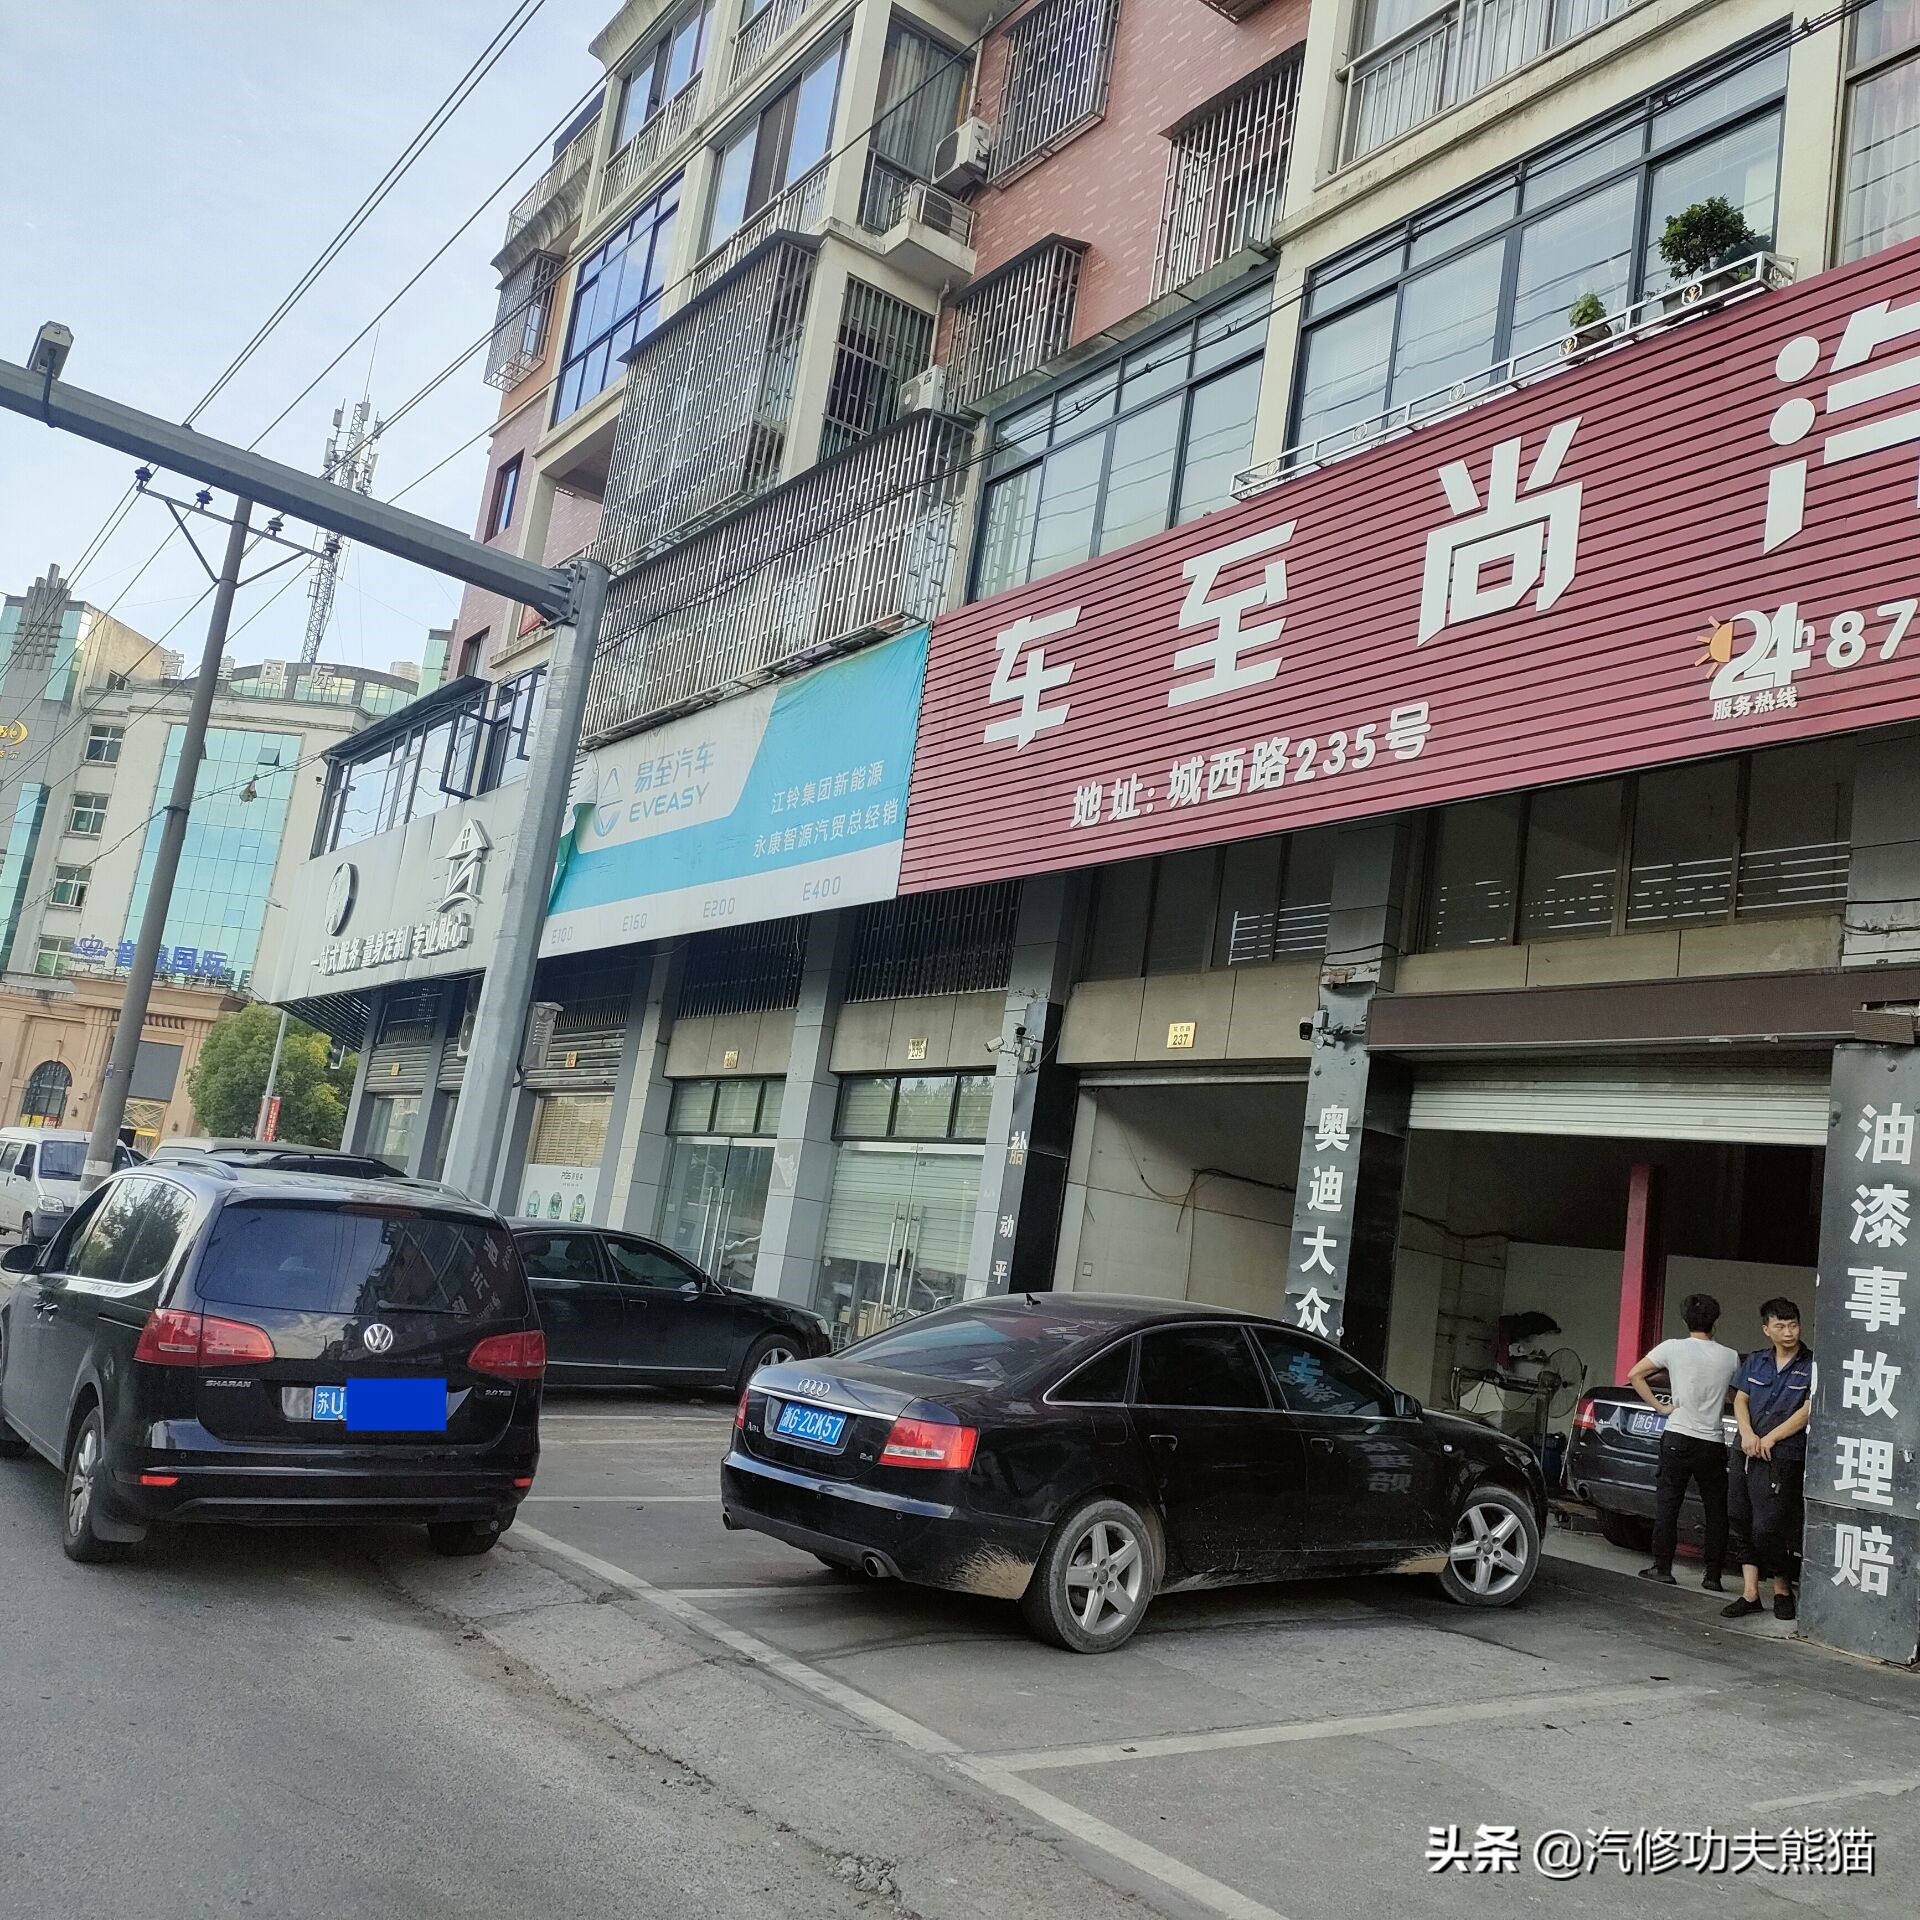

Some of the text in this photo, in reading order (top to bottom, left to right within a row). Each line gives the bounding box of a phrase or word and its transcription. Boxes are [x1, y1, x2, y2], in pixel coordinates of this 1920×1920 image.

[1712, 686, 1798, 721] 服务热线
[634, 742, 717, 794] 易至汽车
[771, 760, 885, 815] 江铃集团新能源
[629, 781, 710, 822] EVEASY
[753, 798, 899, 858] 永康智源汽贸总经销
[551, 876, 841, 944] E100 E160 E200 E400
[1172, 1033, 1189, 1046] 237
[1295, 1104, 1351, 1338] 奥迪大众
[1831, 1102, 1916, 1597] 油漆事故理赔
[204, 1380, 252, 1388] SHARAN
